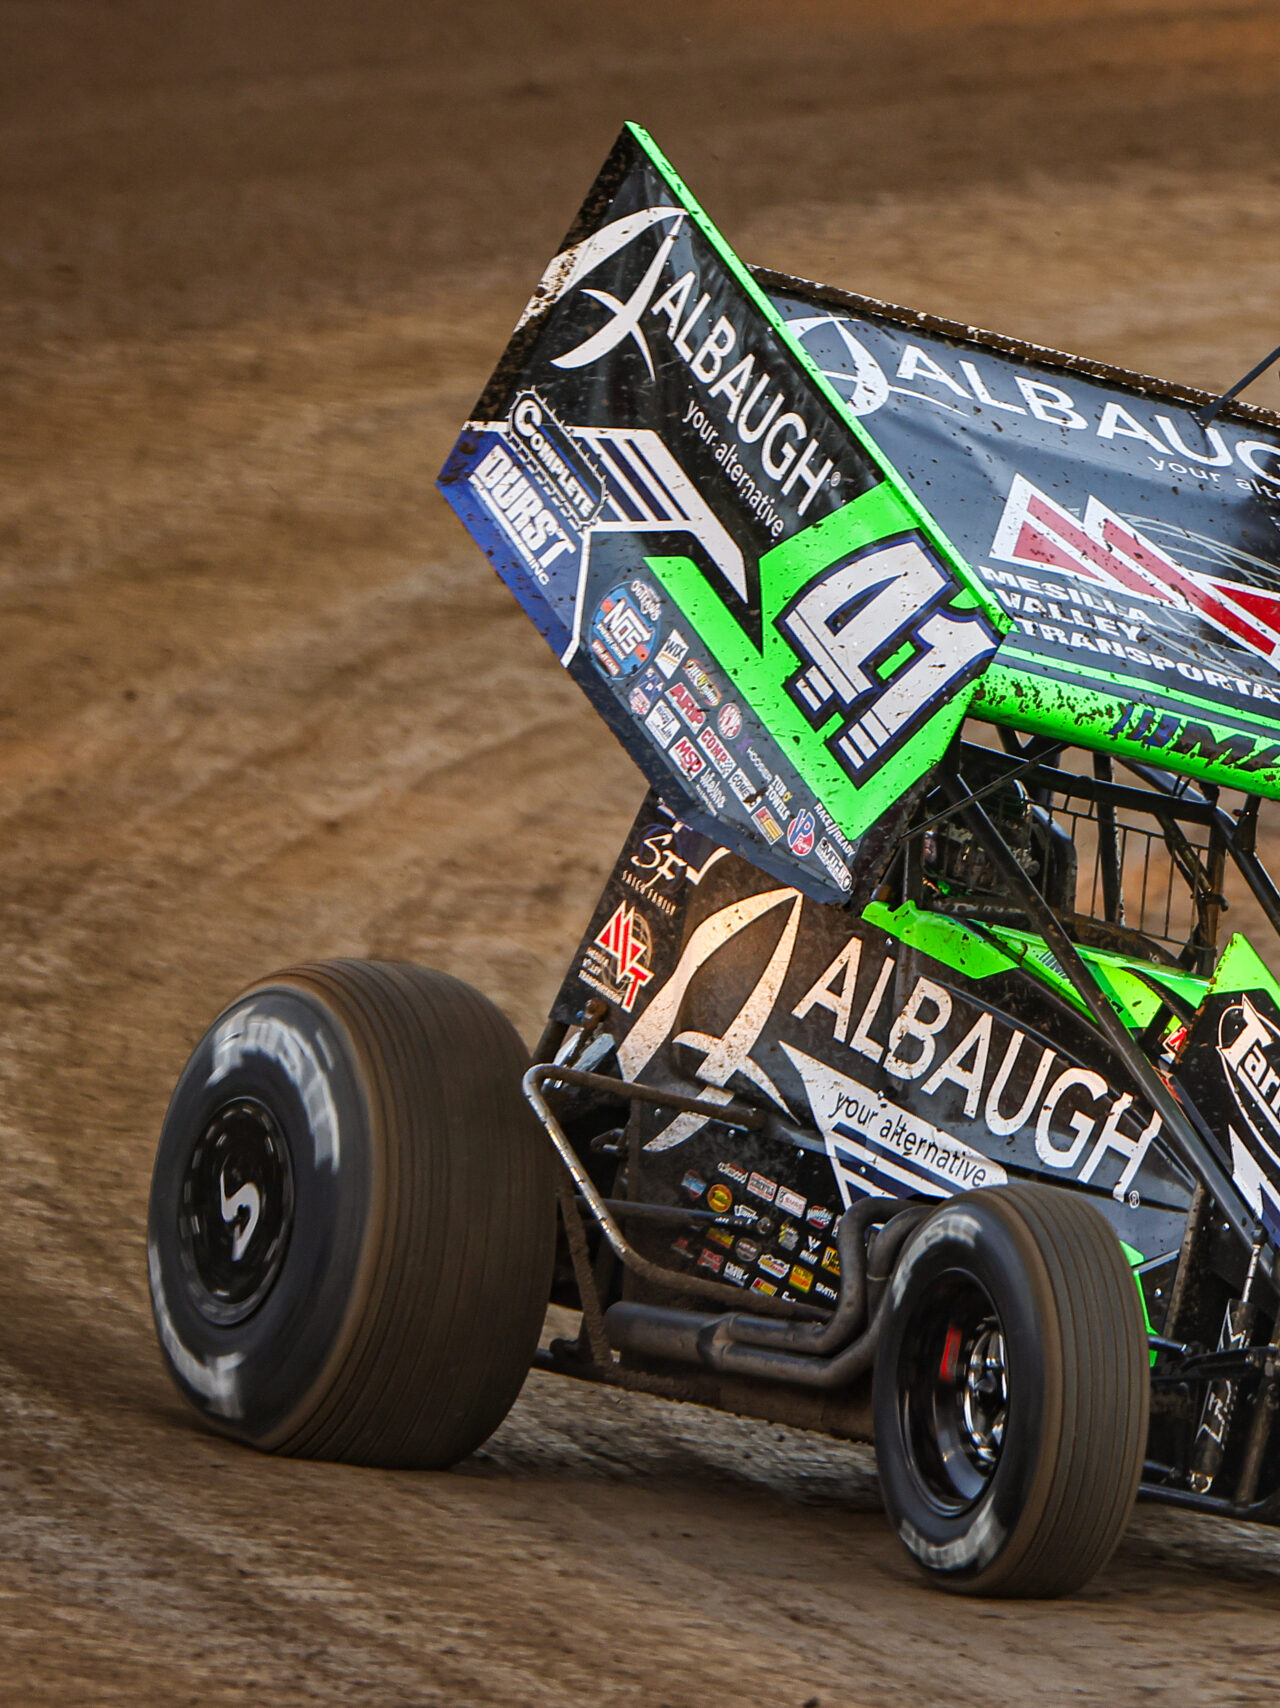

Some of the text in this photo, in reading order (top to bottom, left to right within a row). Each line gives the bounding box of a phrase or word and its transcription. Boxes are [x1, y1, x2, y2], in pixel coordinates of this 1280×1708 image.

[652, 272, 832, 516] ALBAUGH
[514, 400, 595, 517] COMPLETE
[682, 400, 784, 537] your alternative
[1148, 456, 1221, 482] your
[474, 445, 576, 568] DURST
[979, 566, 1157, 626] MESILLA
[995, 587, 1145, 642] VALLEY
[603, 598, 654, 655] NOS
[784, 542, 998, 769] 41
[668, 684, 705, 727] ARP
[675, 740, 703, 772] MSD
[701, 730, 728, 763] COMP
[766, 785, 791, 821] TOWELS
[770, 774, 787, 797] TUB
[791, 936, 1163, 1202] ALBAUGH
[828, 1092, 986, 1187] your alternative
